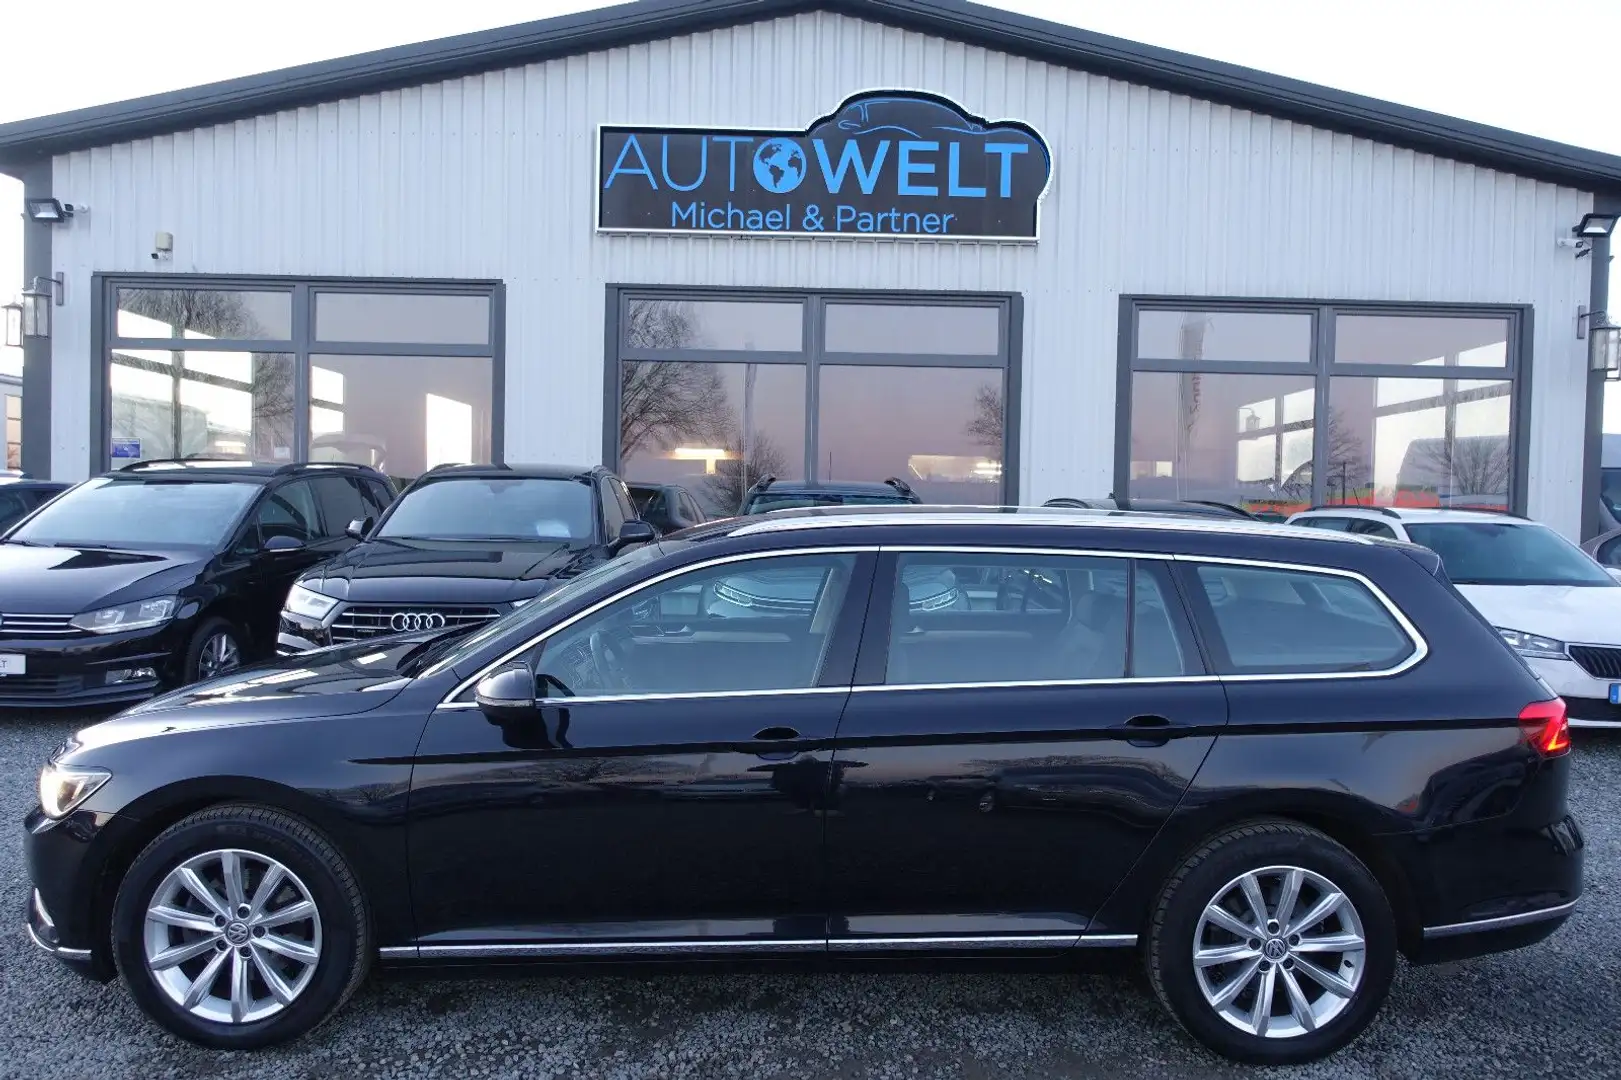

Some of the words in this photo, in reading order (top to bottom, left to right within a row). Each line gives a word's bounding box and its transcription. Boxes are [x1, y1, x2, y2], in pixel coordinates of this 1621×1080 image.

[671, 201, 791, 231] Michael
[801, 204, 825, 232] &
[836, 204, 953, 234] Partner
